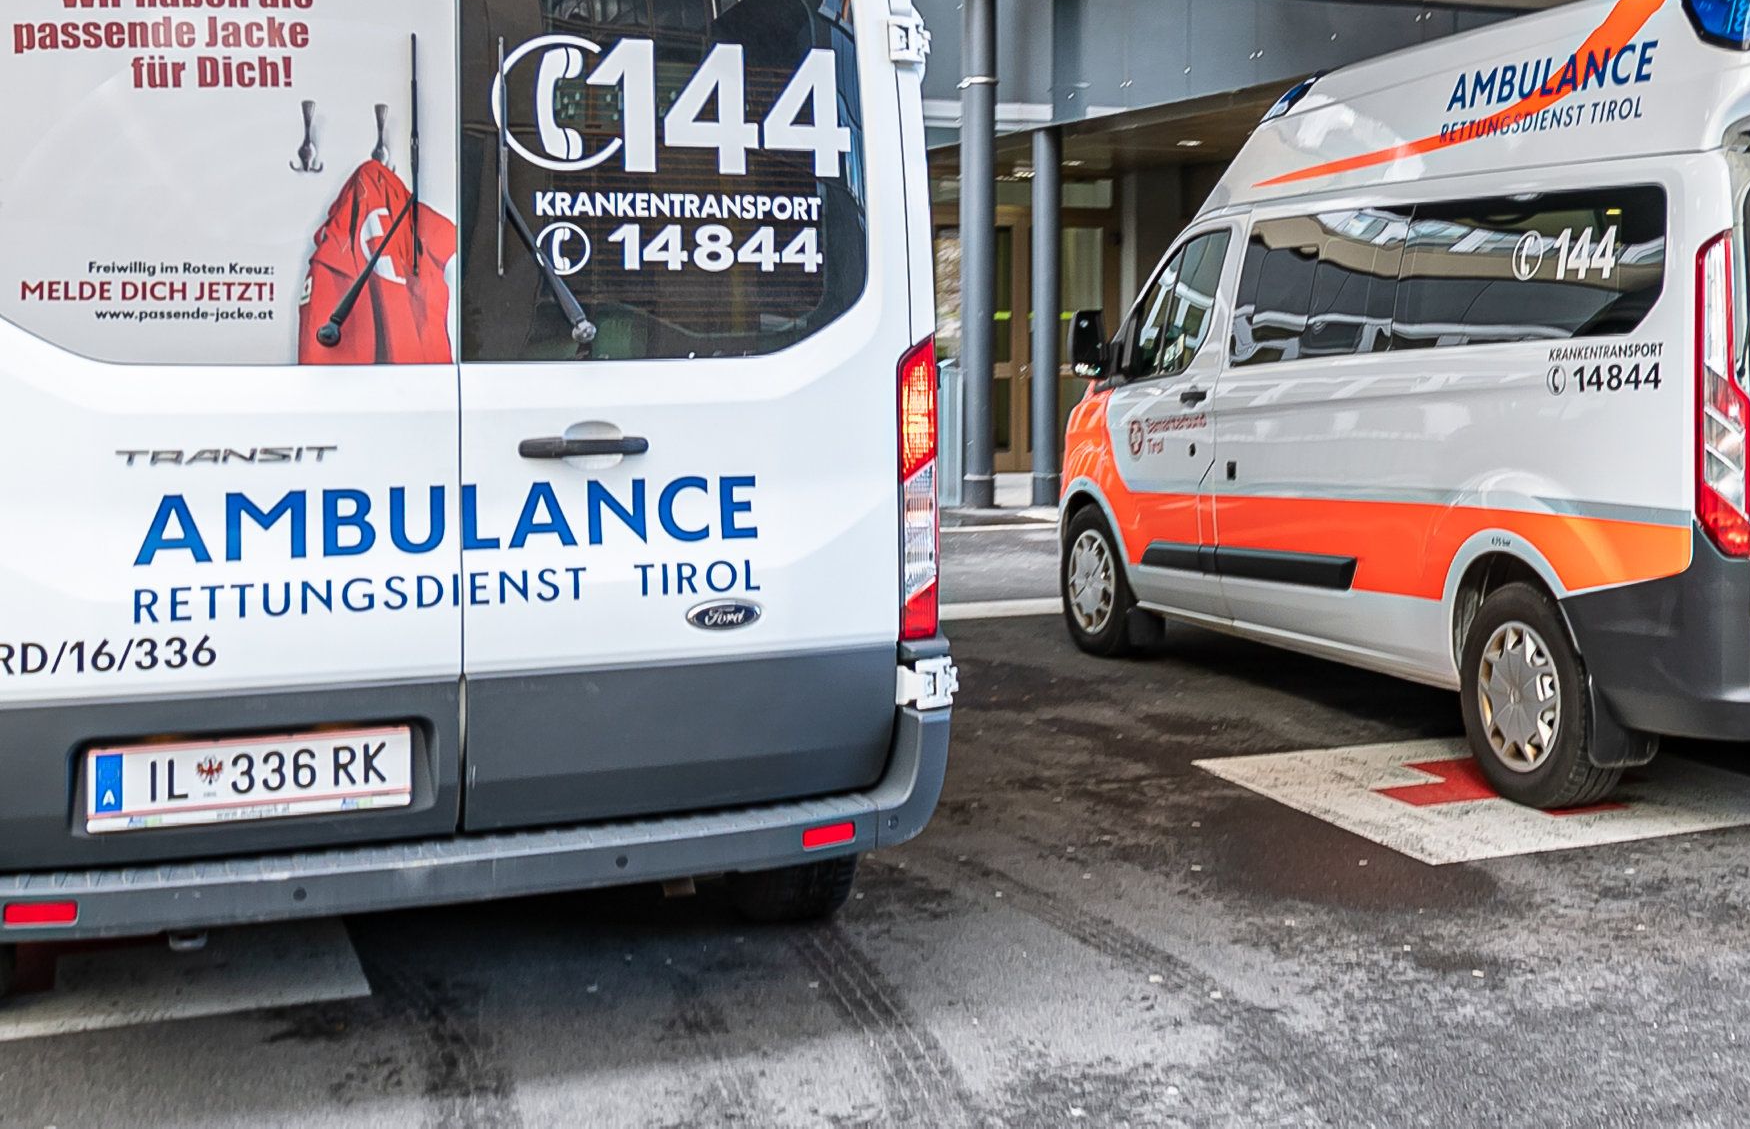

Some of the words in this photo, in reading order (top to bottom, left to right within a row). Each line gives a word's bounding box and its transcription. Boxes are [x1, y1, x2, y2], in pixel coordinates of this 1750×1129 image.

[13, 16, 196, 53] passende
[205, 17, 310, 49] Jacke
[131, 56, 186, 88] für
[197, 56, 293, 88] Dich!
[1445, 40, 1659, 112] AMBULANCE
[586, 37, 852, 178] 144
[1439, 104, 1586, 144] RETTUNGSDIENST
[1590, 96, 1643, 125] TIROL
[535, 191, 823, 221] KRANKENTRANSPORT
[608, 223, 824, 273] 14844
[1554, 225, 1618, 280] 144
[88, 261, 156, 276] Freiwillig
[160, 262, 178, 274] im
[183, 262, 225, 275] Roten
[229, 263, 274, 275] Kreuz:
[20, 280, 112, 301] MELDE
[121, 281, 187, 301] DICH
[195, 282, 275, 302] JETZT!
[95, 307, 274, 322] www.passende-jacke.at
[1549, 342, 1664, 362] KRANKENTRANSPORT
[1573, 362, 1662, 393] 14844
[115, 445, 337, 466] TRANSIT
[133, 475, 758, 567] AMBULANCE
[133, 567, 587, 624] RETTUNGSDIENST
[633, 559, 761, 597] TIROL
[705, 608, 745, 625] Ford
[150, 759, 189, 803] IL
[231, 749, 316, 794] 336
[332, 741, 386, 787] RK
